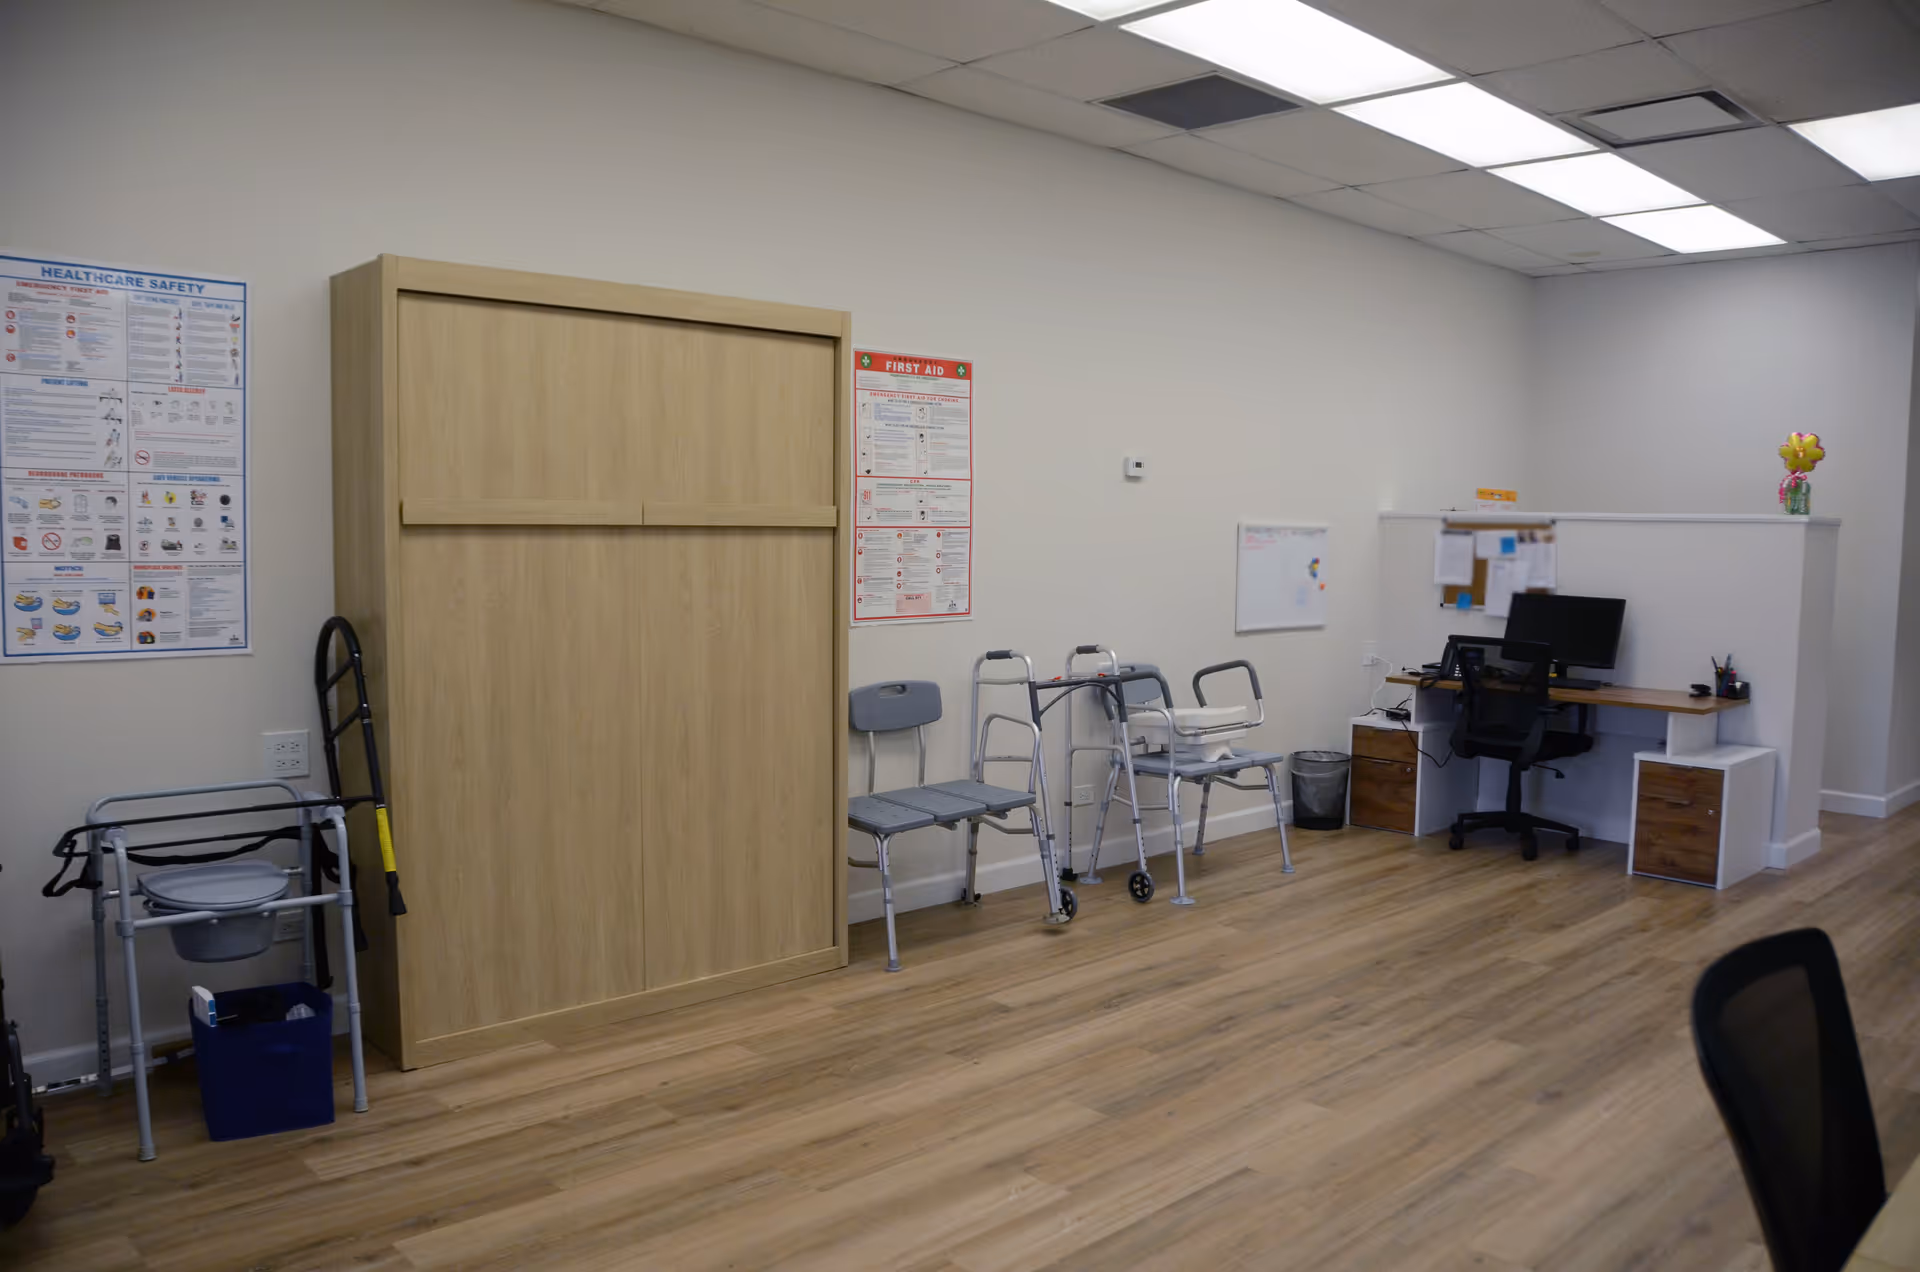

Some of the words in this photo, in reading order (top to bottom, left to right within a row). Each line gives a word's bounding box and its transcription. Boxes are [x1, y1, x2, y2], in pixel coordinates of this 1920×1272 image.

[41, 266, 145, 288] HEALTHCARE
[149, 279, 205, 295] SAFETY
[886, 360, 920, 374] FIRST
[925, 364, 944, 376] AID
